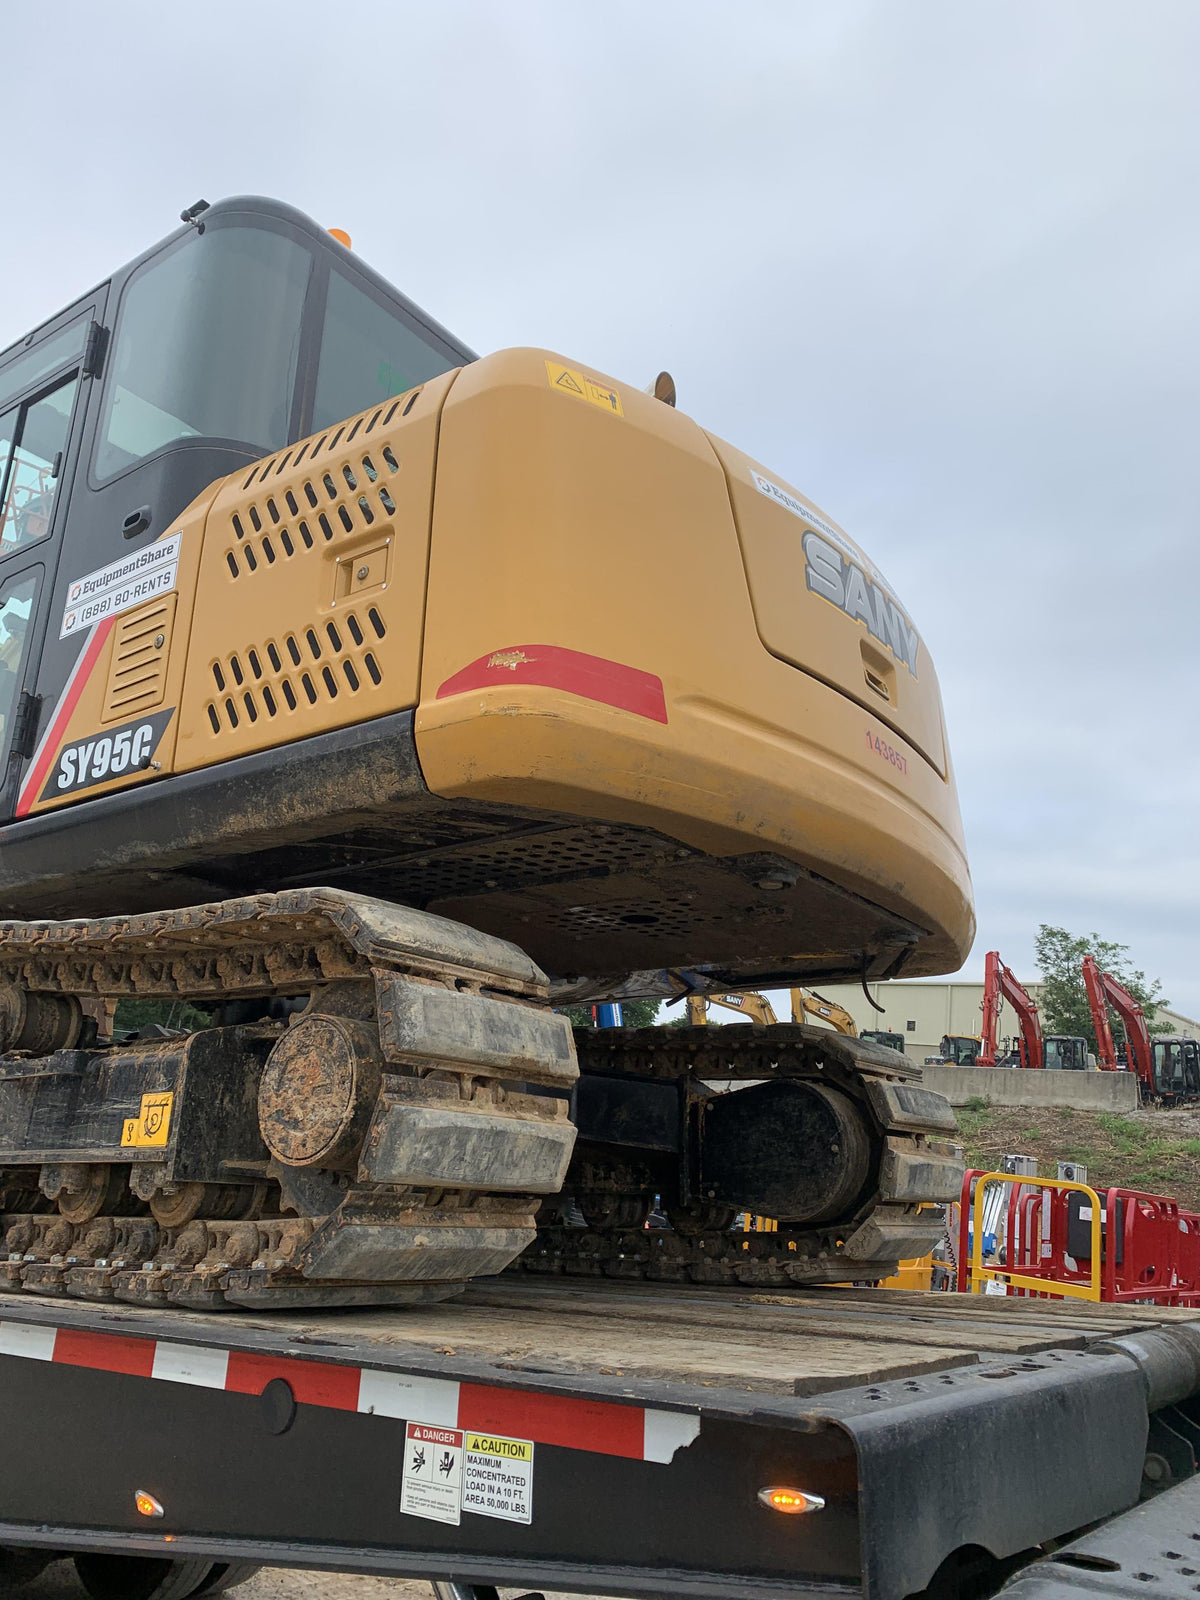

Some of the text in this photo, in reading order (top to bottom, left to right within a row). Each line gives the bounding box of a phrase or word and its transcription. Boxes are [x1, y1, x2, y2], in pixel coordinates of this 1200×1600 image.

[82, 544, 174, 594] EquipmentShare
[81, 571, 171, 622] (888) 80-RENTS
[801, 529, 918, 681] SANY
[57, 724, 153, 789] SY95C
[866, 730, 907, 775] 143857
[422, 1429, 455, 1444] DANGER
[481, 1439, 526, 1458] CAUTION
[467, 1455, 502, 1469] MAXIMUM
[466, 1468, 526, 1487] CONCENTRATED
[466, 1481, 524, 1501] LOAD IN A 10 FT.
[465, 1494, 486, 1506] AREA
[486, 1497, 509, 1511] 50,000
[510, 1503, 528, 1515] LBS.
